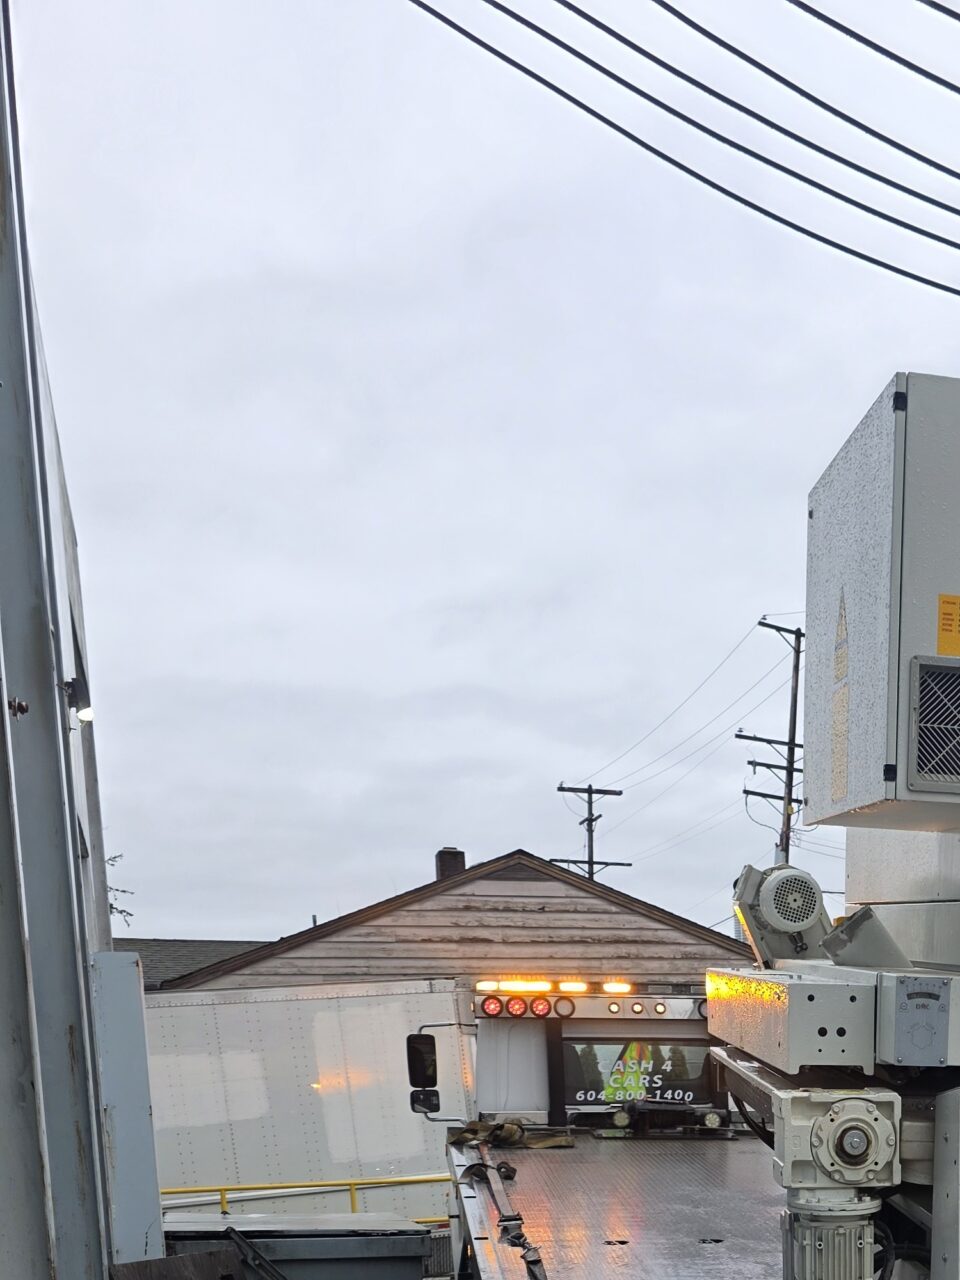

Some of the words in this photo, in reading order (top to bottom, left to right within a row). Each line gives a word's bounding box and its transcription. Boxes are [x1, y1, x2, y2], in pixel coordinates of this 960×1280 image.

[597, 1060, 654, 1073] CASH
[661, 1060, 673, 1072] 4
[608, 1074, 663, 1088] CARS
[575, 1089, 694, 1102] 604-800-1400
